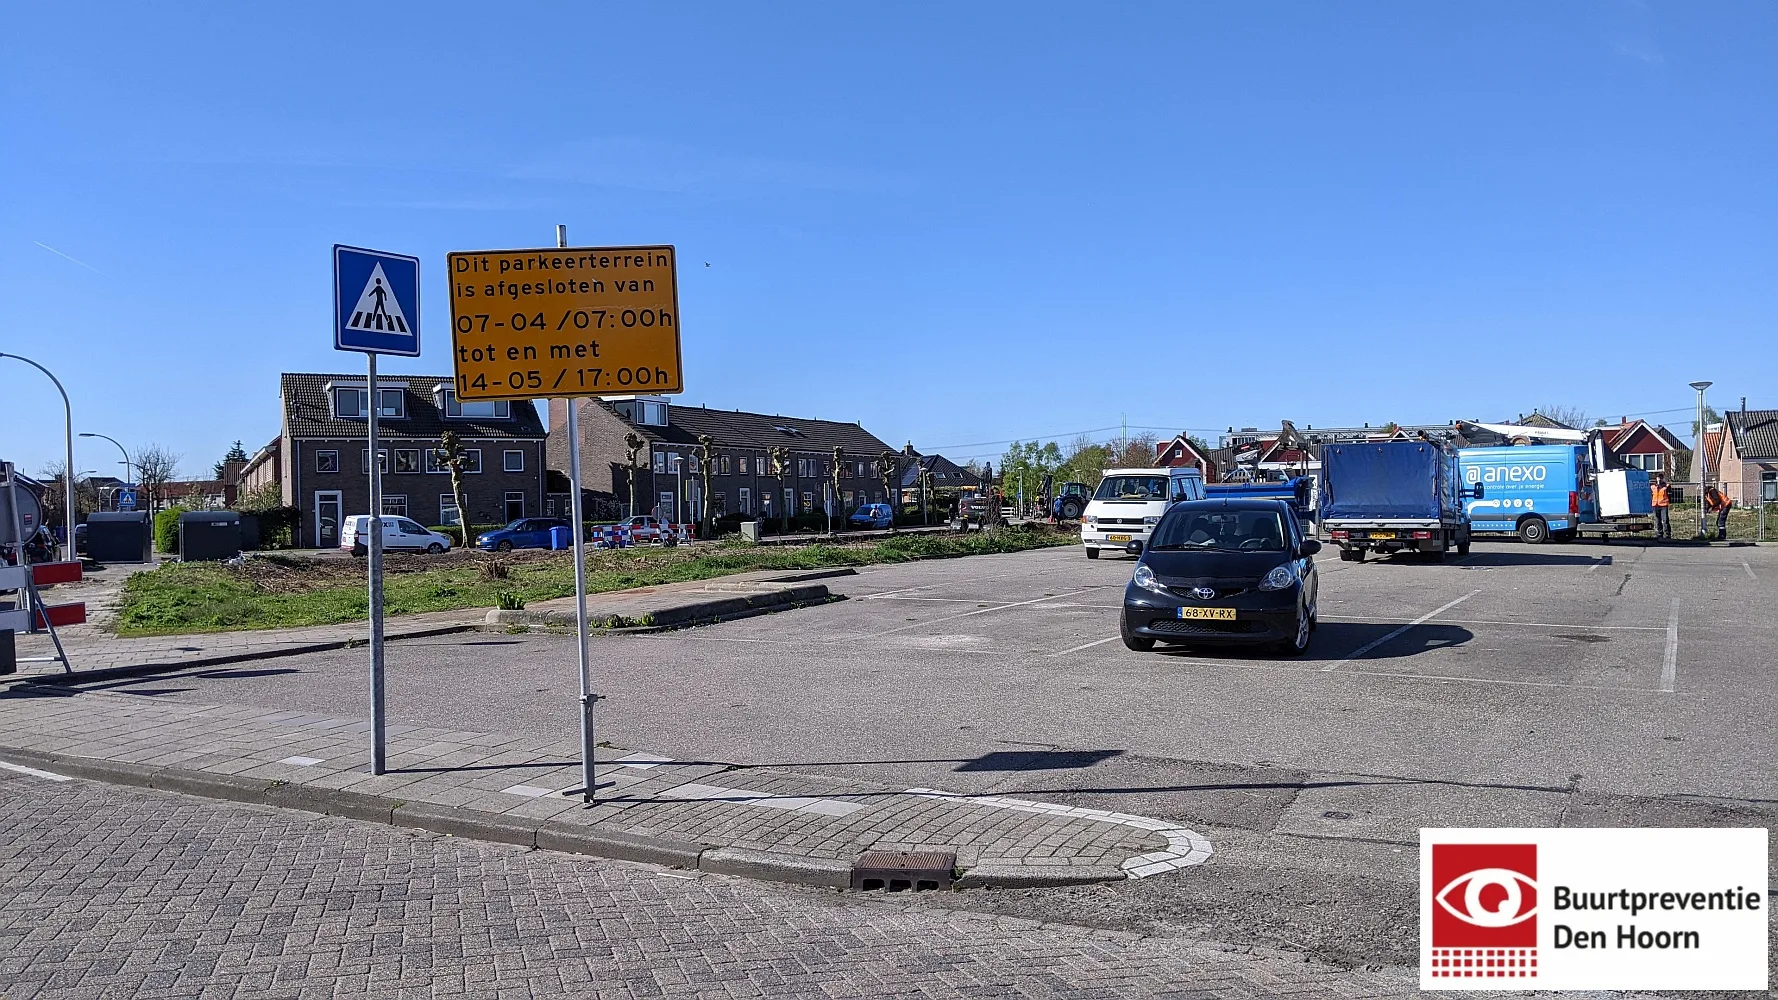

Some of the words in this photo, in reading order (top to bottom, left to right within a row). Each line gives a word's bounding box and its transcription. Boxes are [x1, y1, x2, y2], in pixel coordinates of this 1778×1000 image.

[456, 257, 489, 273] Dit
[500, 253, 668, 274] parkeerterrein
[457, 283, 475, 298] is
[484, 278, 605, 300] afgesloten
[614, 279, 655, 293] van
[457, 312, 547, 334] 07-04
[458, 344, 496, 363] tot
[507, 345, 537, 361] en
[550, 340, 600, 359] met
[460, 370, 542, 392] 14-05
[577, 366, 668, 387] 17:00h
[1185, 608, 1232, 619] 68-XV-RX
